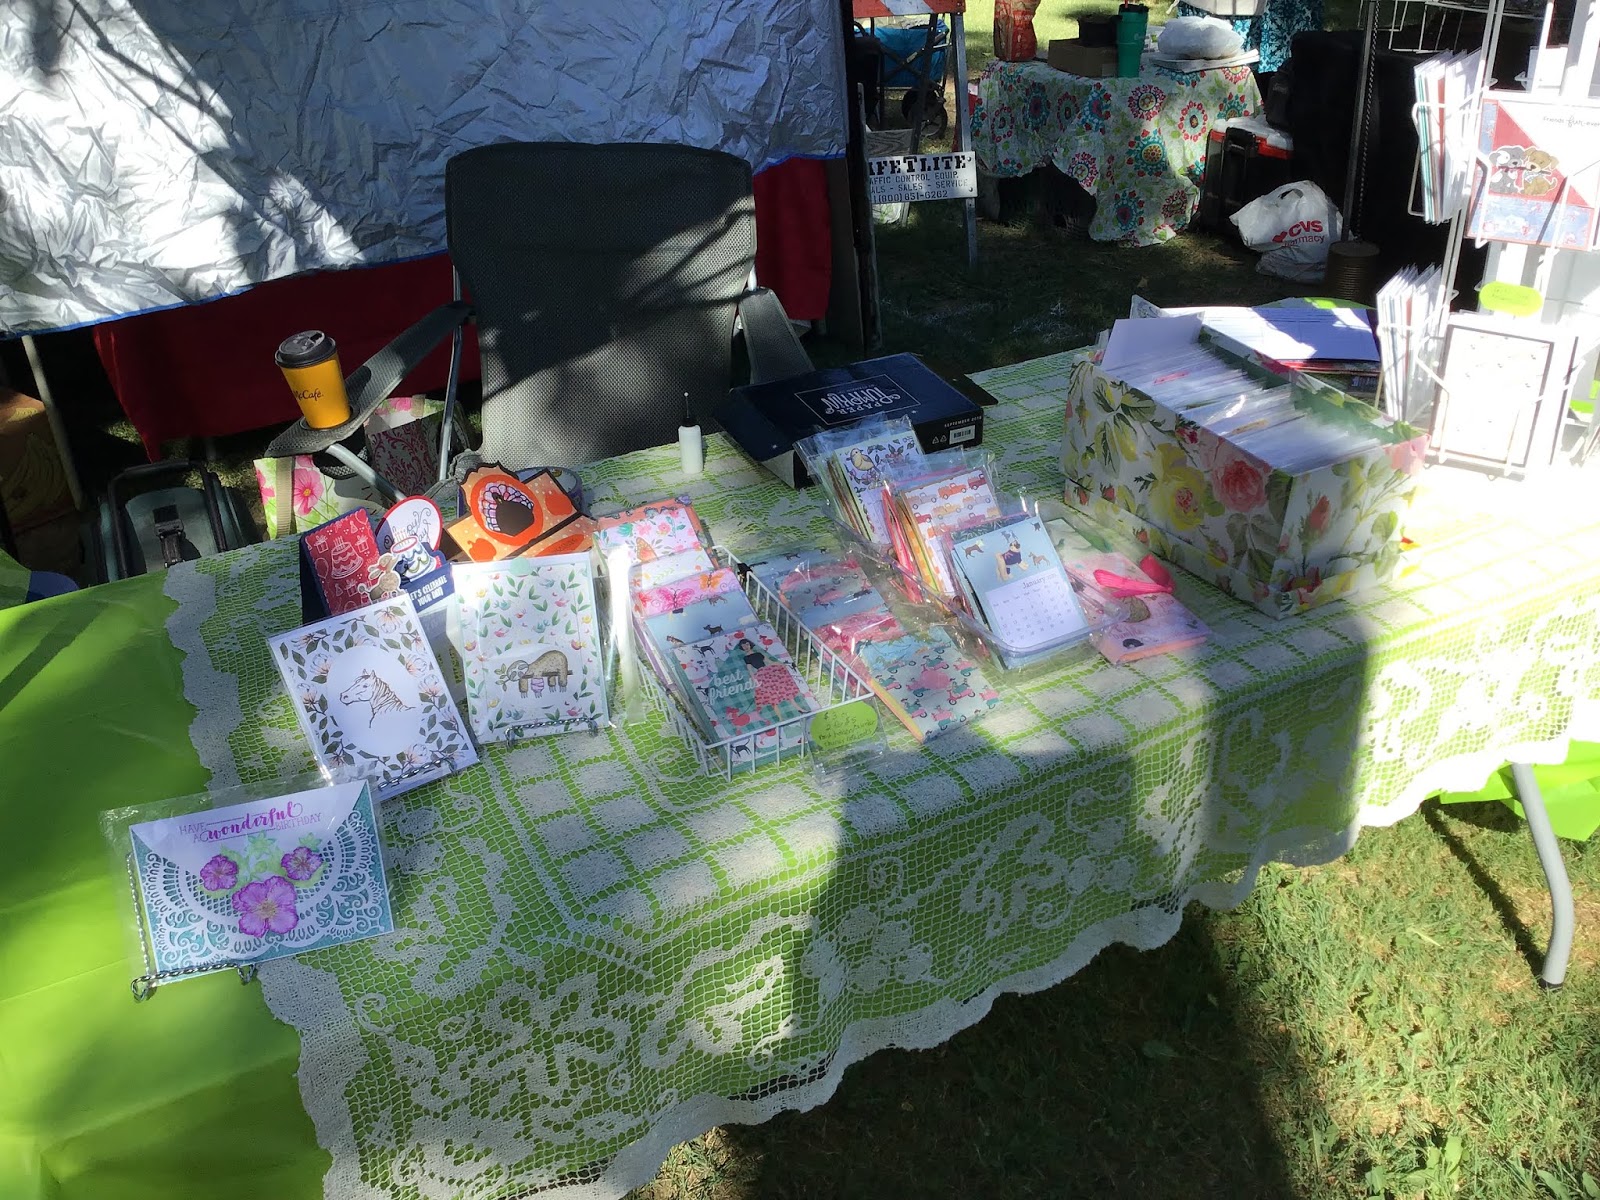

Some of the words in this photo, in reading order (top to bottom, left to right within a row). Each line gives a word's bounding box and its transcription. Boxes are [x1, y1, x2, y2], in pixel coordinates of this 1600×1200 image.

[868, 155, 966, 176] AFETLITE
[869, 176, 891, 185] AFFIC
[895, 173, 929, 183] CONTROL
[935, 171, 959, 179] EQUIP.
[871, 185, 886, 194] ALS
[898, 182, 923, 192] SALES
[936, 179, 968, 188] SERVICE
[1288, 220, 1323, 237] CVS
[1285, 235, 1325, 247] armacy
[836, 401, 882, 415] PAPER
[944, 418, 970, 428] SEPTEMBER
[410, 588, 422, 601] ET'S
[422, 574, 448, 594] CELEBRATE
[1022, 576, 1046, 589] January
[417, 594, 433, 607] YOUR
[712, 669, 744, 686] best
[708, 678, 762, 705] friends
[179, 822, 206, 835] HAVE
[200, 801, 304, 842] wonderful
[274, 812, 322, 831] BIRTHDAY
